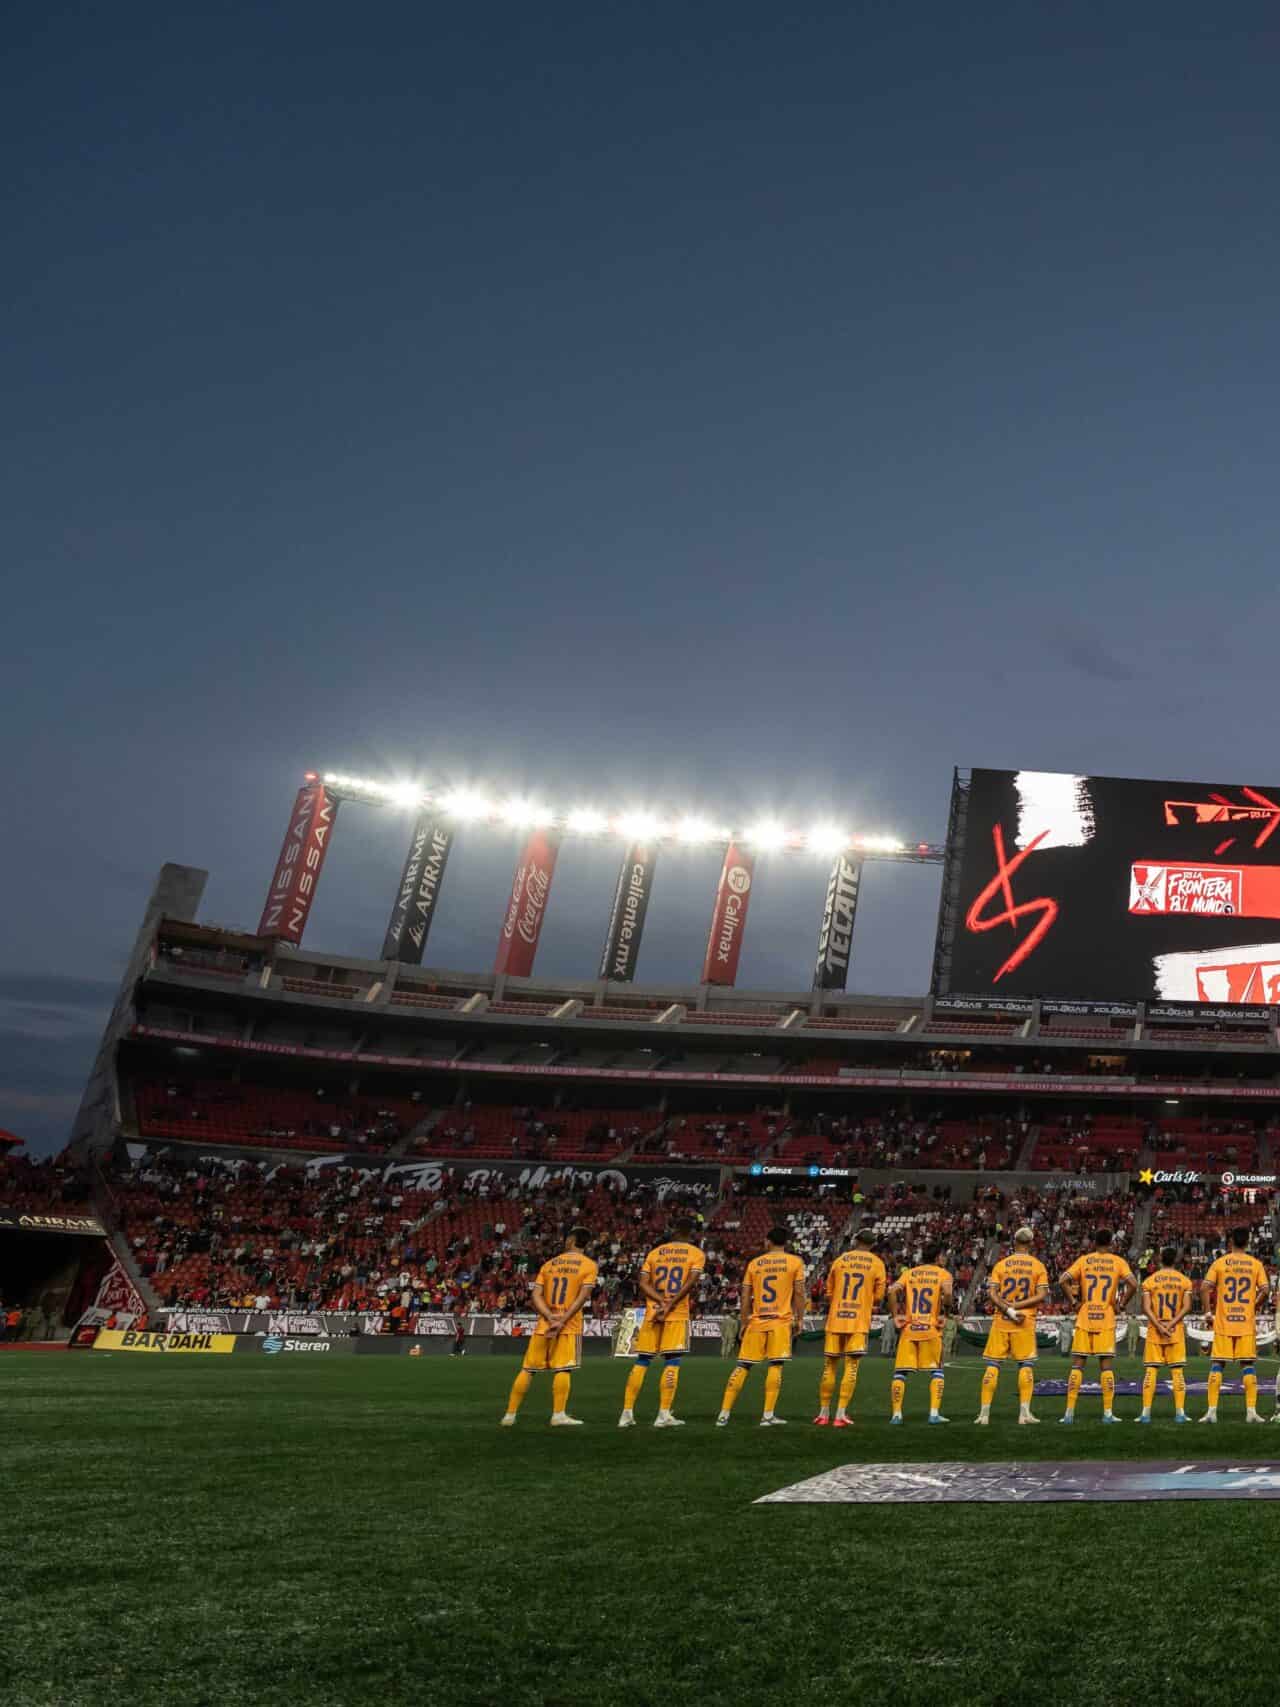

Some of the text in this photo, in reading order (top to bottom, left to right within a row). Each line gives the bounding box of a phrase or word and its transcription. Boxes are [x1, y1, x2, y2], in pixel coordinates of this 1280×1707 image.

[266, 793, 314, 927] NISSAN
[288, 792, 336, 933] NISSAN
[416, 829, 449, 918] AFIRME
[1168, 872, 1232, 901] FRONTERA
[613, 863, 645, 976] caliente.mx
[825, 854, 860, 975] TECATE
[718, 895, 742, 963] Calimax
[19, 1215, 98, 1227] AFIRME
[552, 1277, 568, 1305] 11
[655, 1266, 683, 1294] 28
[762, 1275, 778, 1303] 5
[842, 1272, 865, 1300] 17
[1001, 1277, 1031, 1301] 23
[1086, 1274, 1112, 1301] 77
[1224, 1276, 1251, 1303] 32
[911, 1287, 933, 1314] 16
[1158, 1293, 1178, 1319] 14
[121, 1332, 213, 1352] BARDAHL
[284, 1340, 330, 1352] Steren
